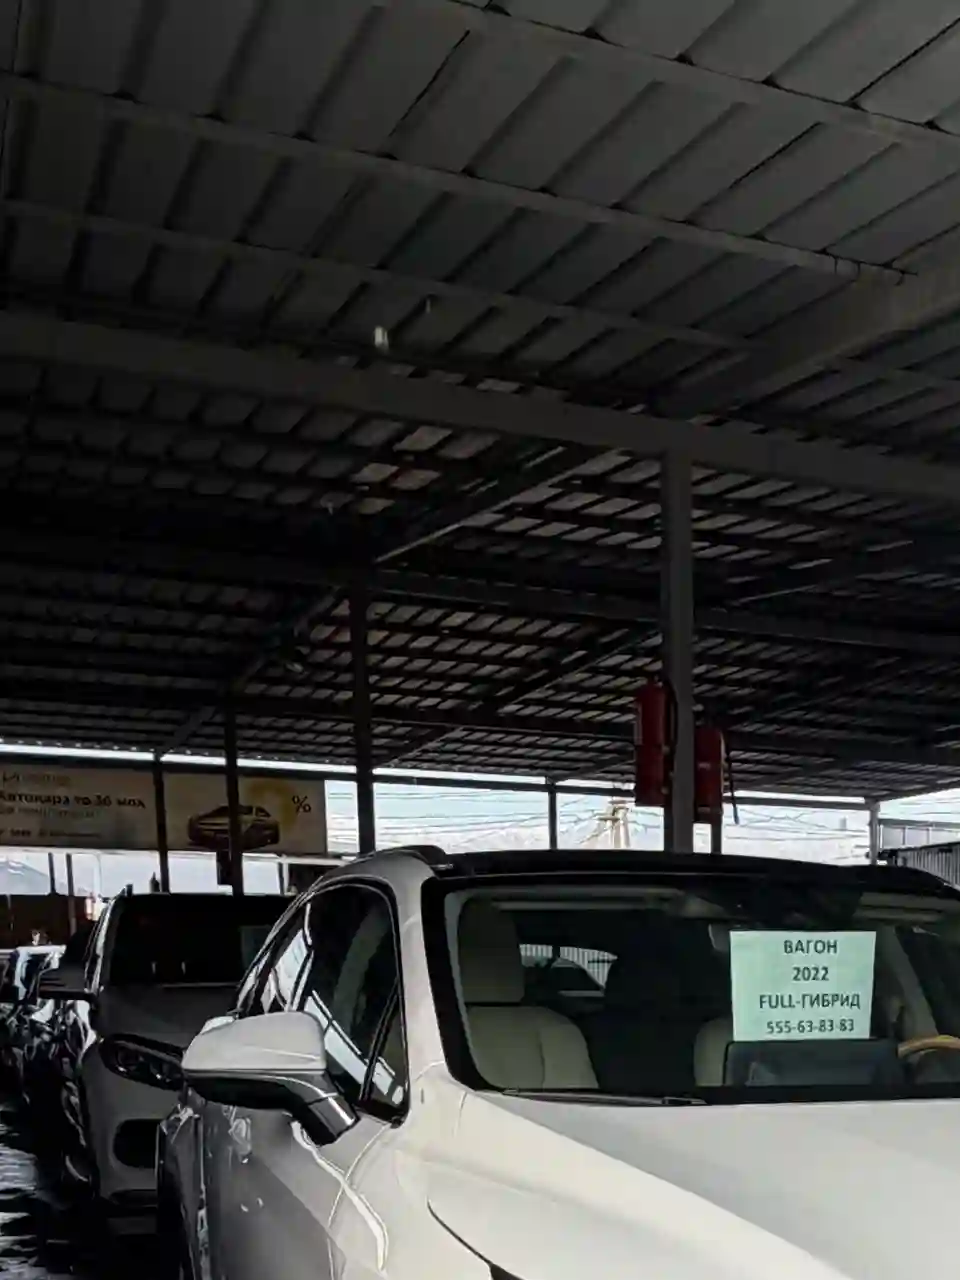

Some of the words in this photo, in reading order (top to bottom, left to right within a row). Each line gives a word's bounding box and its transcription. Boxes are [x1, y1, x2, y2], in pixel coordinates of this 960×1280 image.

[783, 938, 838, 954] ВАГОН
[792, 966, 830, 981] 2022
[759, 993, 861, 1010] FULL-ГИБРИД
